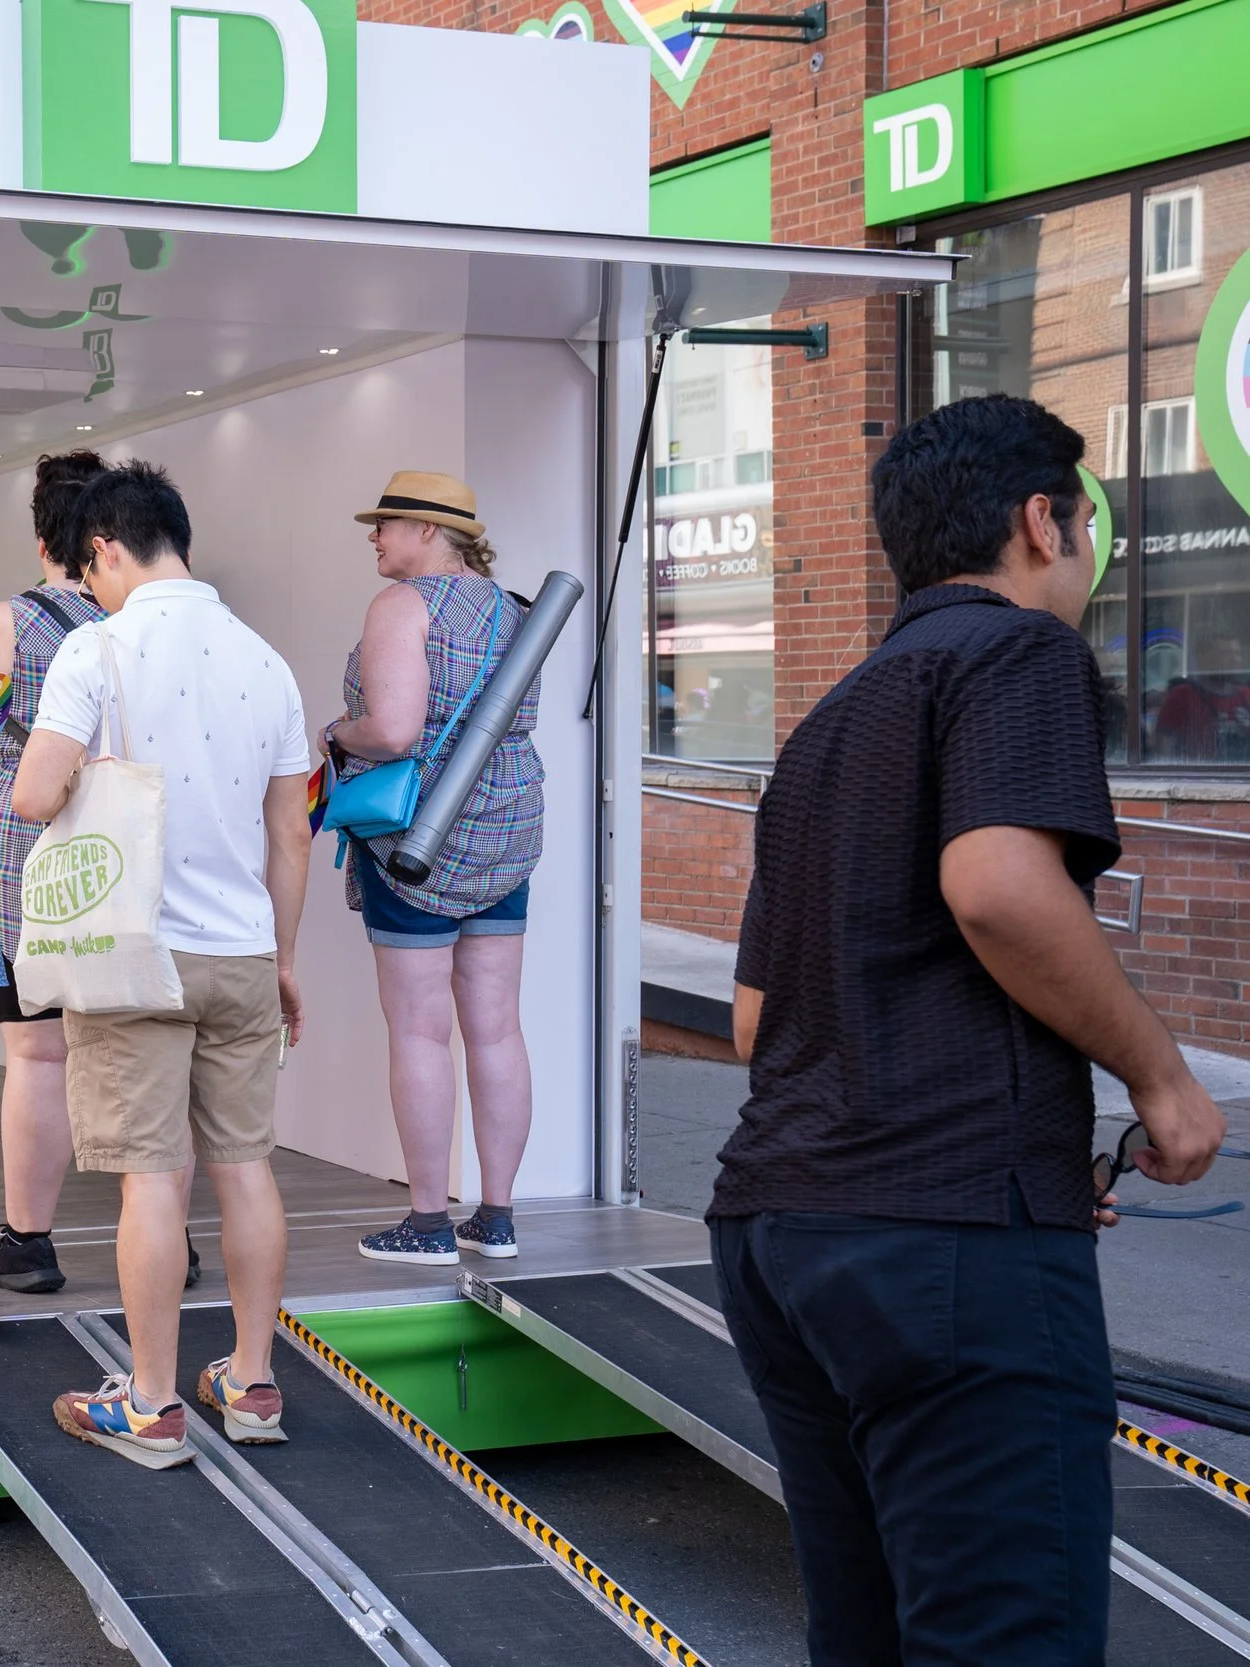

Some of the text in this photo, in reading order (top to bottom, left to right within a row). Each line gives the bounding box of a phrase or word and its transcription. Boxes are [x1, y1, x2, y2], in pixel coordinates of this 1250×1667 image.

[78, 0, 329, 172] TD
[872, 103, 955, 193] TD
[25, 843, 107, 886] CAMP FRIENDS
[25, 864, 108, 916] FOREVER
[27, 939, 66, 956] CAMP
